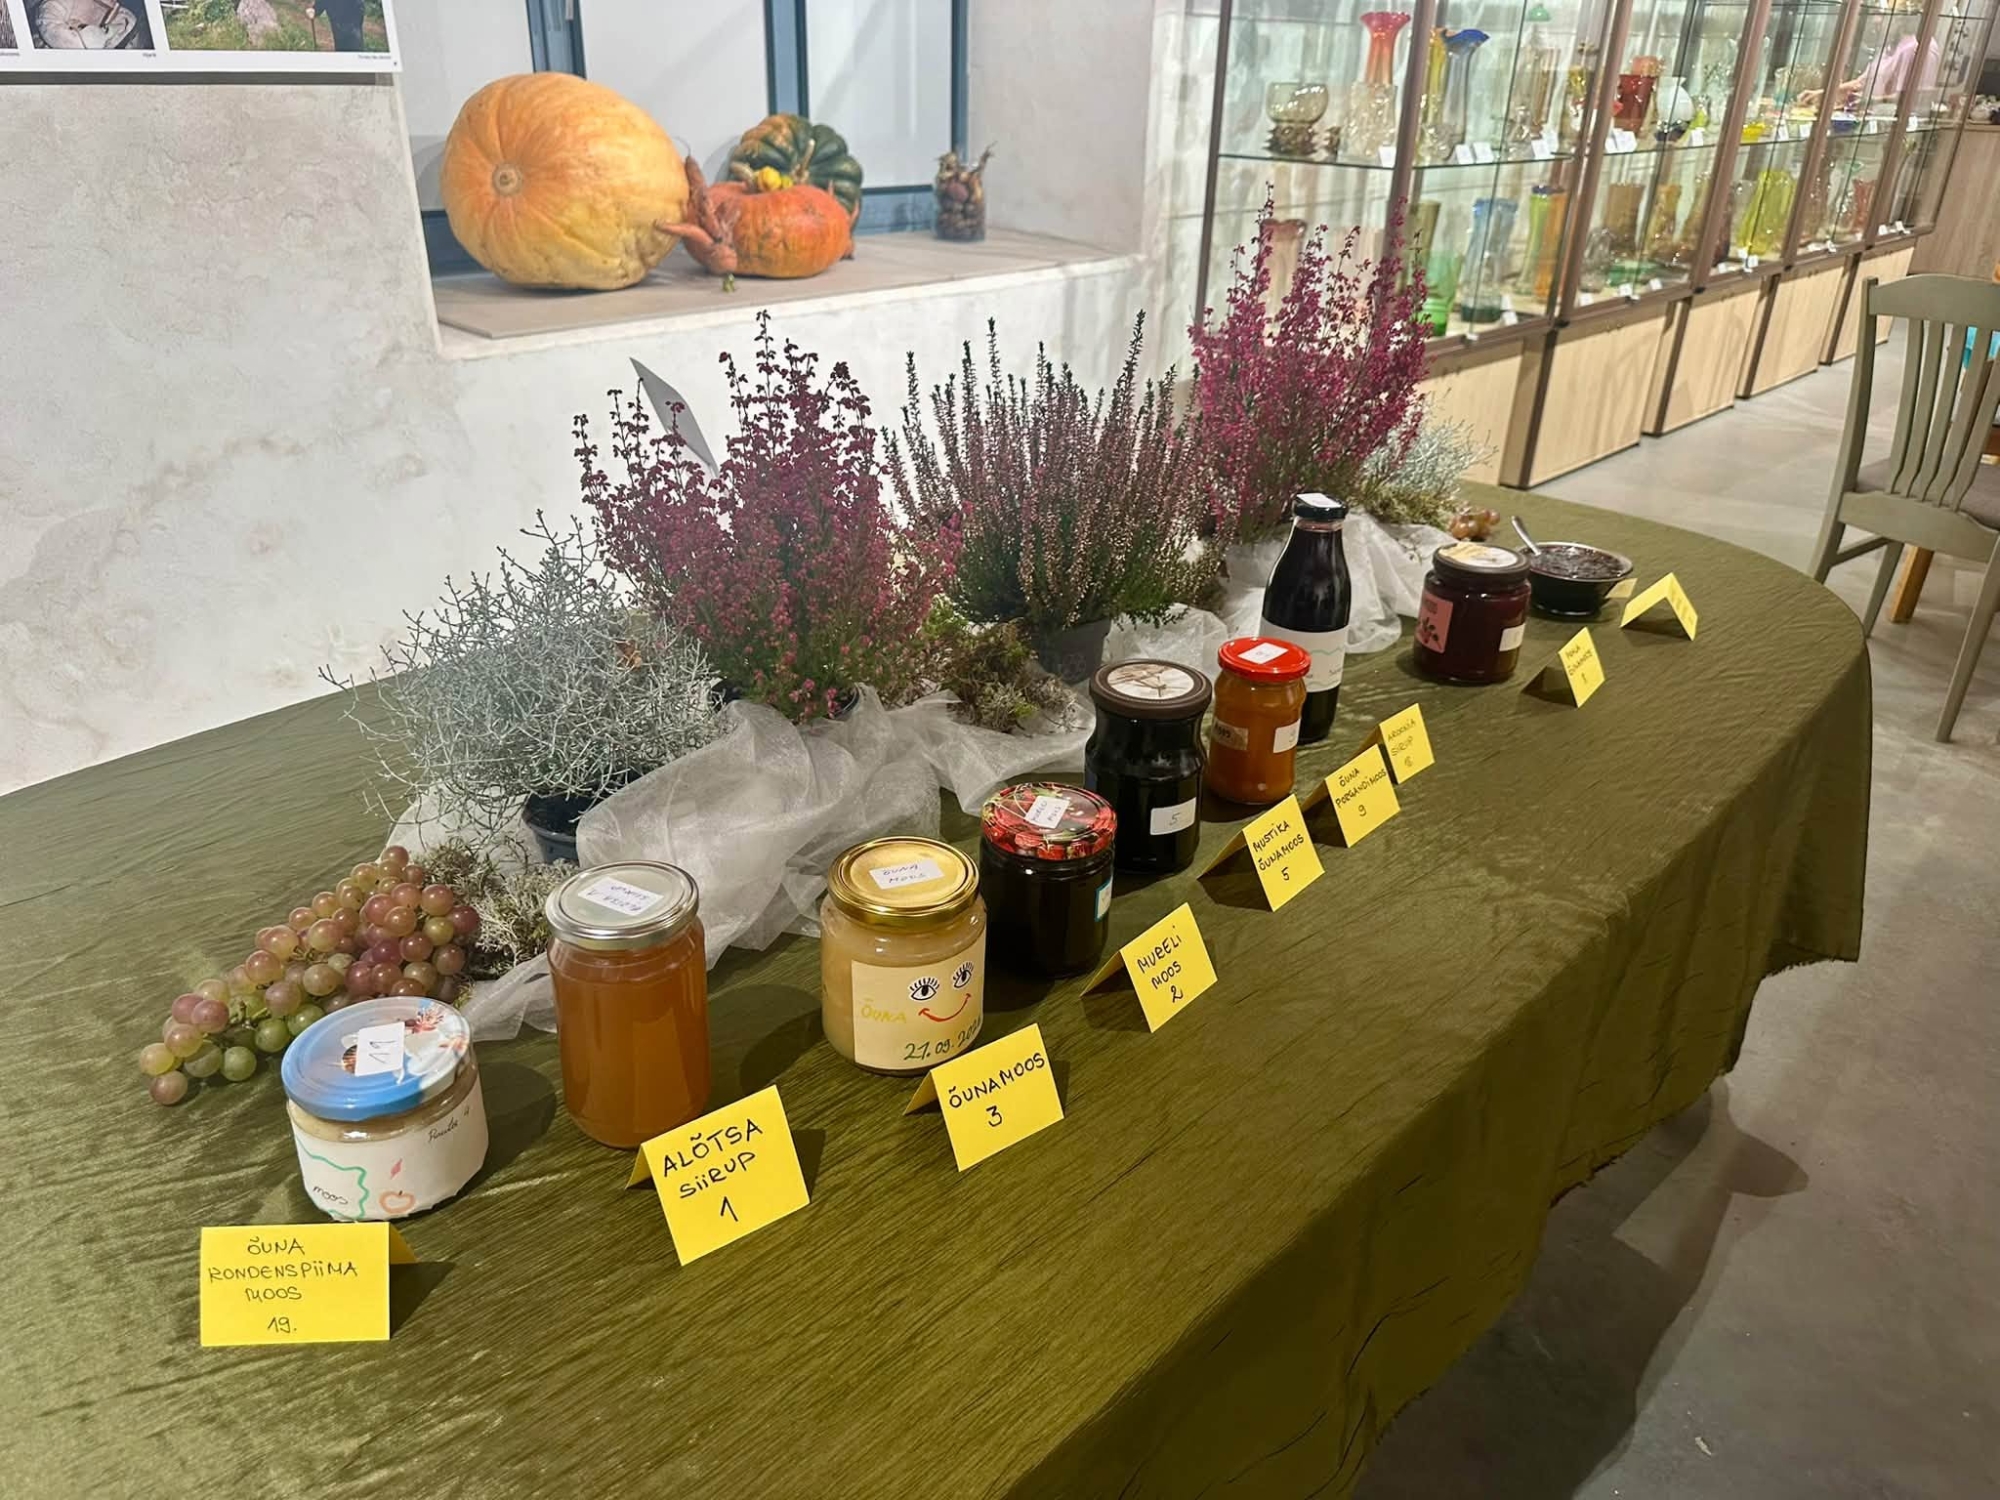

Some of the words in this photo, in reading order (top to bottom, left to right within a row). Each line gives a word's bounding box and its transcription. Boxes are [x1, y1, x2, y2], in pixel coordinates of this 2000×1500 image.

[1338, 768, 1360, 787] ÕUNA
[1358, 804, 1367, 817] 9
[1258, 833, 1304, 871] ÕUNAMOOS
[1281, 866, 1290, 881] 5
[1151, 960, 1182, 990] MOOS
[1170, 985, 1184, 1003] 2
[948, 1052, 1045, 1108] ÕUNAMOOS
[986, 1105, 1003, 1128] 3
[664, 1118, 763, 1177] ALÕTSA
[313, 1185, 348, 1205] moos
[720, 1196, 739, 1222] 1
[247, 1236, 305, 1256] ÕUNA
[245, 1285, 302, 1302] MOOS
